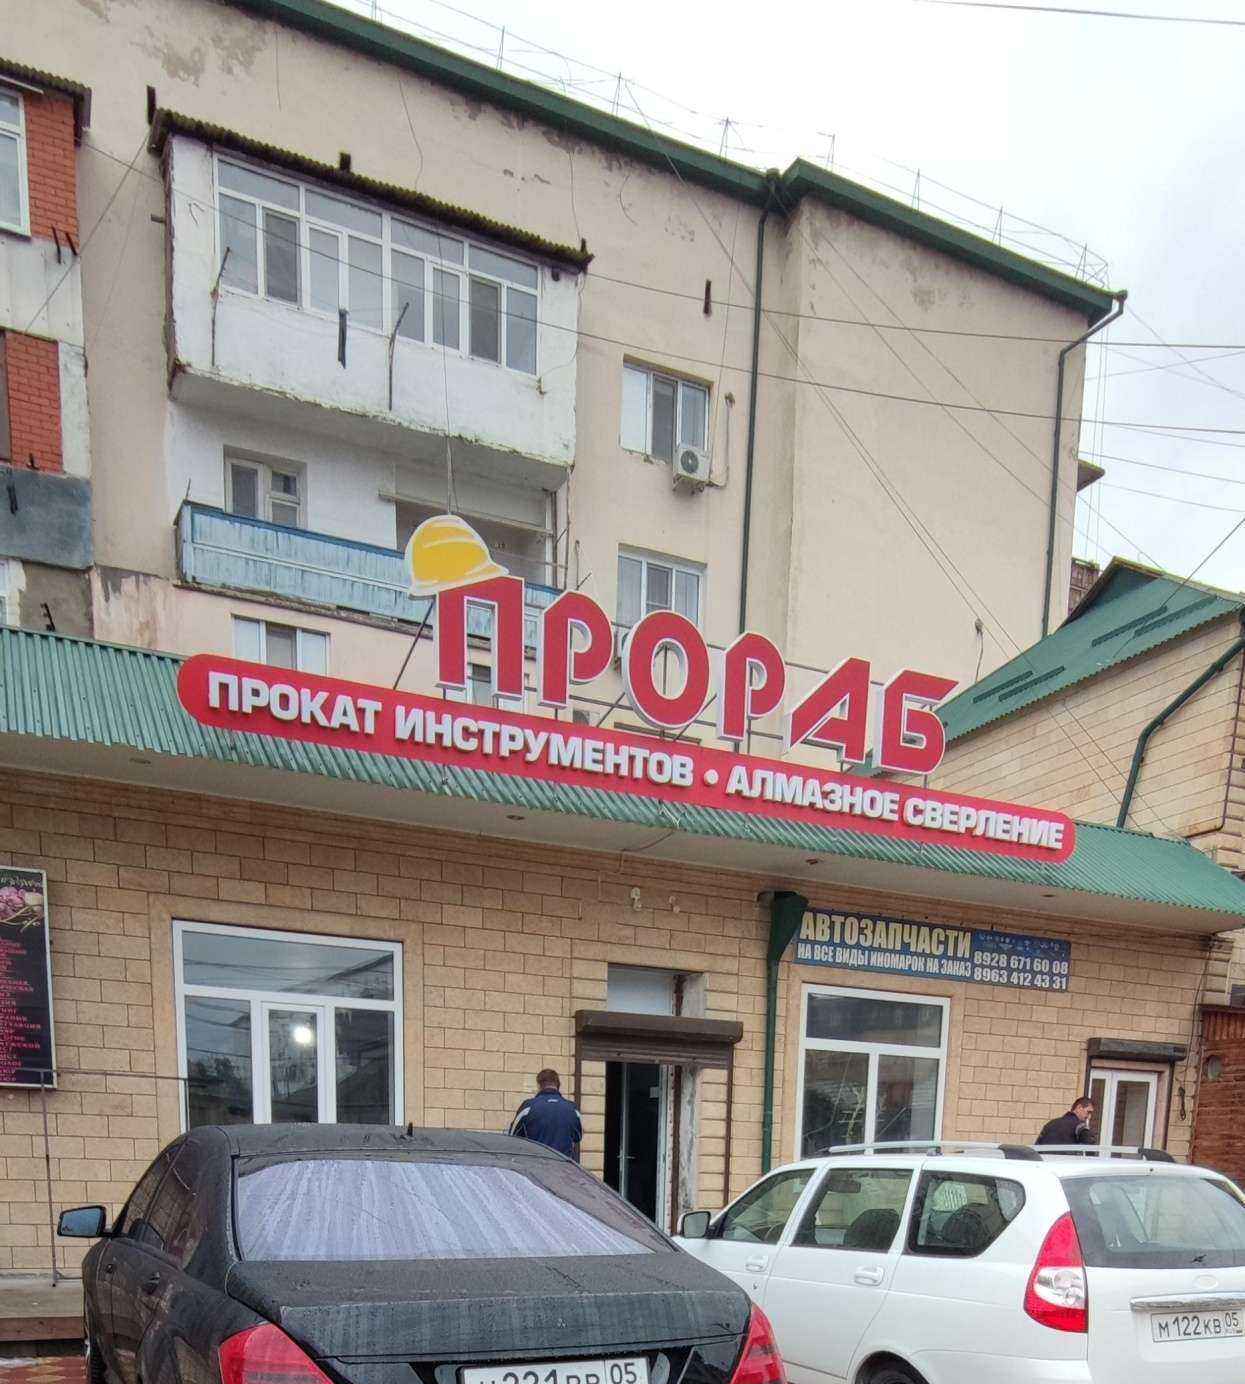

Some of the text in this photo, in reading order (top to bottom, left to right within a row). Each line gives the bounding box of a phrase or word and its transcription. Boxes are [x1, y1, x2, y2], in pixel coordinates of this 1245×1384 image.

[434, 575, 959, 775] ПРОРАБ
[208, 670, 694, 788] ПРОКАТ ИНСТРУМЕНТОВ
[726, 765, 1065, 850] АЛМАЗНОЕ СВЕРЛЕНИЕ
[800, 911, 972, 959] АВТОЗАПЧАСТИ
[797, 942, 972, 978] НА ВСЕ ВИДЫ ИНОМАРОК НА ЗАКАЗ
[973, 966, 1067, 990] 8963 412 43 31
[974, 950, 1069, 975] 8928 671 60 08
[1225, 1312, 1239, 1327] 05
[610, 1362, 637, 1384] 05
